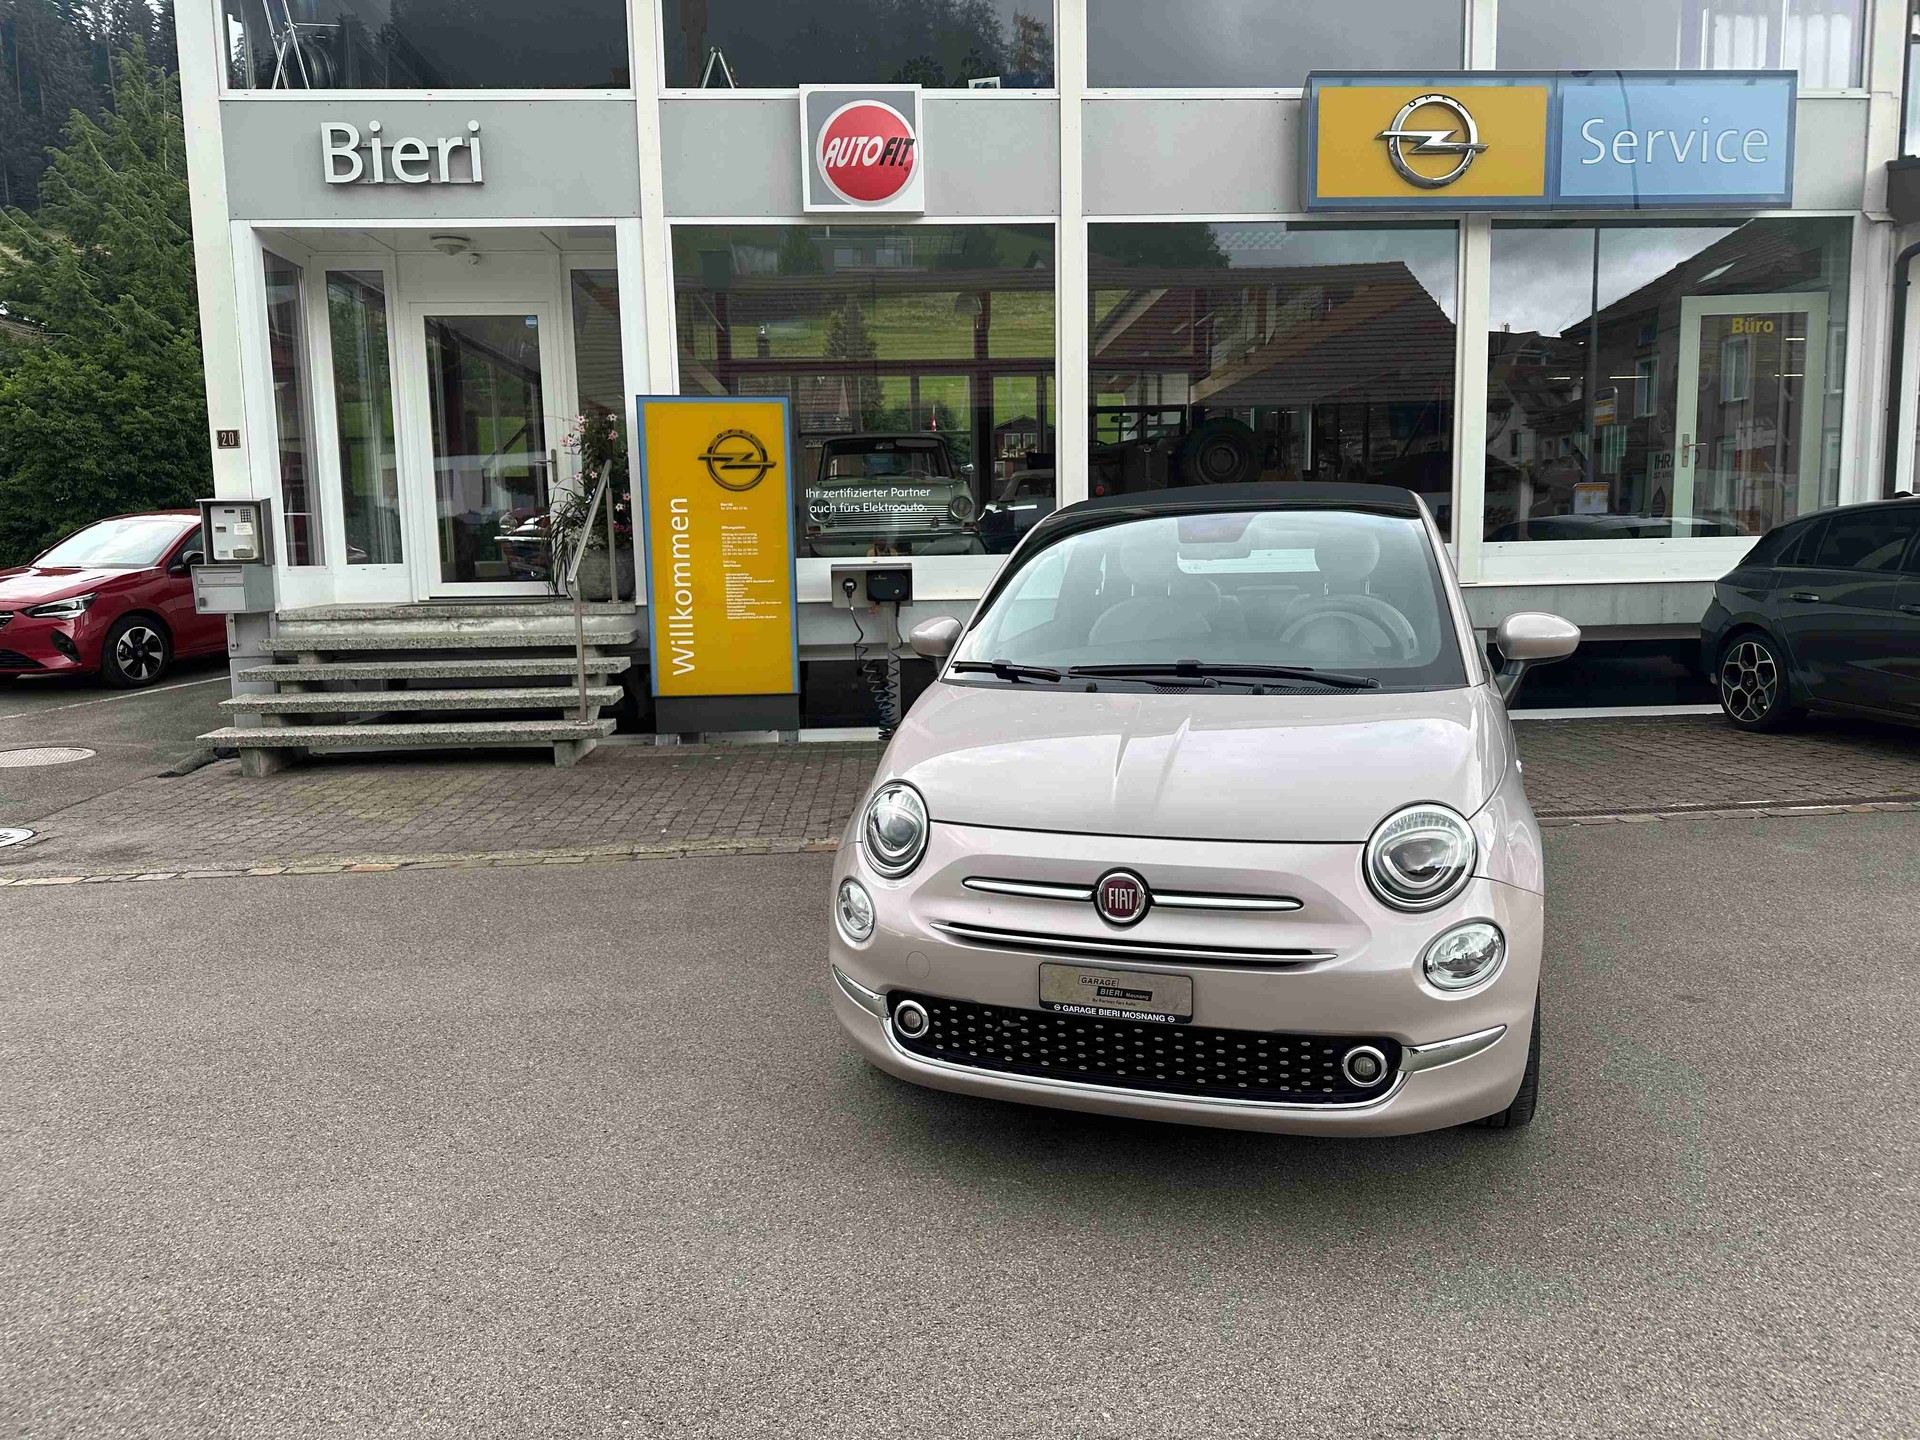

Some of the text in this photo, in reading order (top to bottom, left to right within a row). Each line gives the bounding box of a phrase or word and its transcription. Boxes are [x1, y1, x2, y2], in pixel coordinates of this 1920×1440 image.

[1408, 95, 1462, 109] OPEL
[1581, 115, 1769, 164] Service
[320, 119, 483, 184] Bieri
[824, 136, 915, 168] AUTOFIT
[1731, 317, 1774, 335] Büro
[221, 431, 235, 446] 20
[717, 428, 755, 439] OPEL
[805, 487, 931, 498] Ihr zertifizierter Partner
[809, 503, 837, 513] auch
[839, 502, 860, 513] fürs
[668, 497, 696, 677] Willkommen
[1108, 887, 1135, 910] FIAT
[1081, 977, 1117, 987] GARAGE
[1100, 988, 1149, 1001] BIERI Mosnang
[1062, 1004, 1166, 1022] GARAGE BIERI MOSNANG
